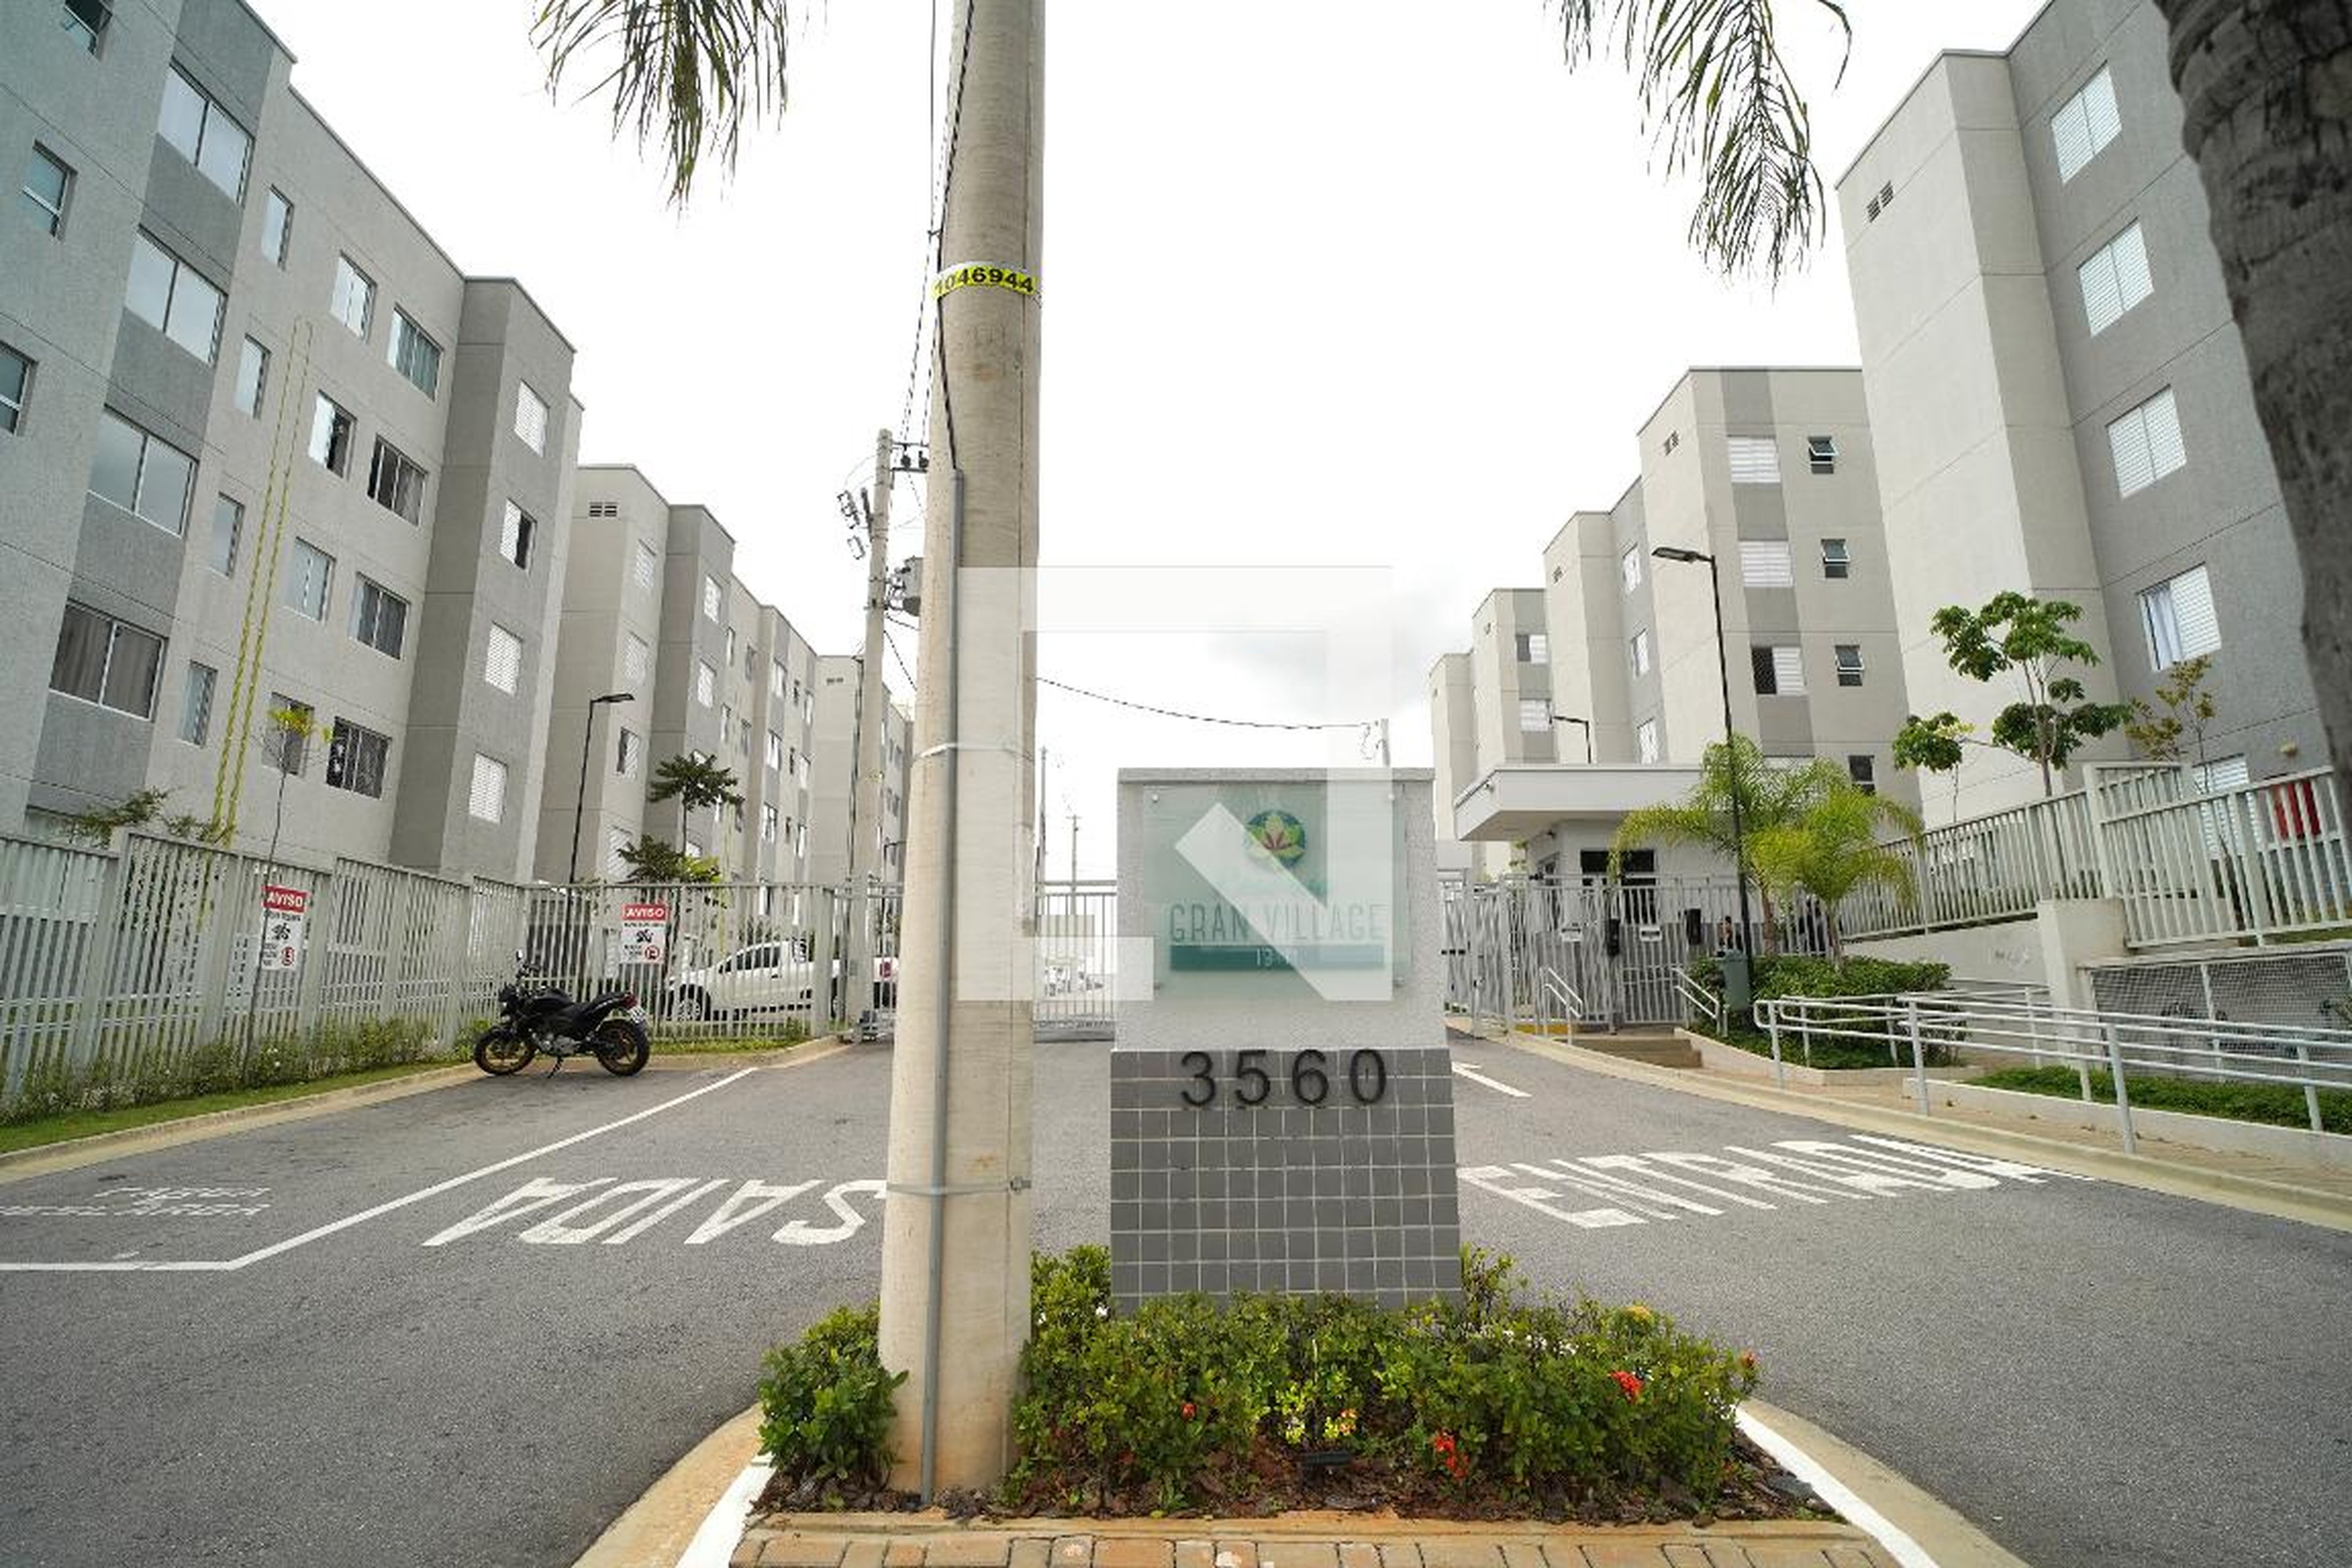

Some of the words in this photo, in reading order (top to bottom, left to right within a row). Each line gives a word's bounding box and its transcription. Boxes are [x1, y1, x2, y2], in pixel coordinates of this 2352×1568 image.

[268, 891, 303, 908] AVISO
[626, 908, 665, 917] AVISO
[1169, 903, 1251, 943] GRAN
[1263, 903, 1389, 941] VILLAGE
[1181, 1049, 1387, 1106] 3560
[1457, 1135, 2094, 1227] ENTRADA
